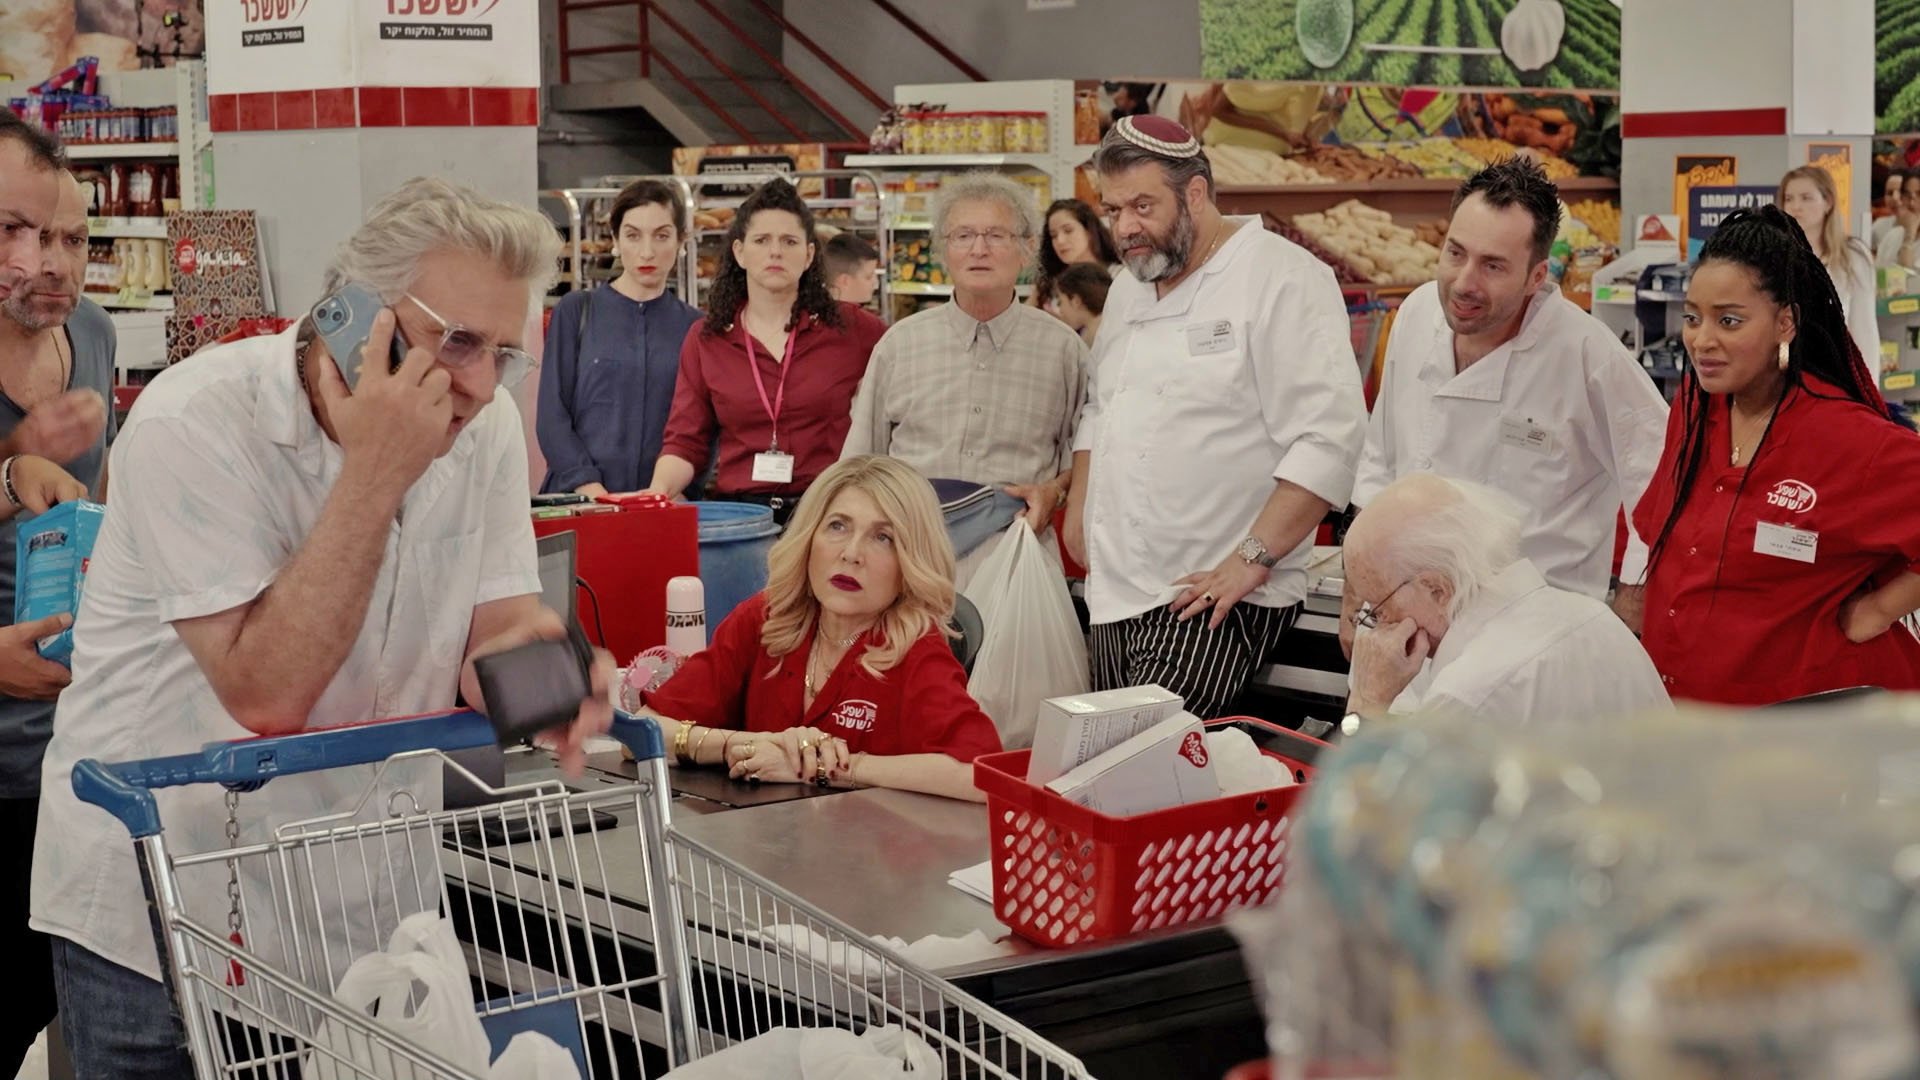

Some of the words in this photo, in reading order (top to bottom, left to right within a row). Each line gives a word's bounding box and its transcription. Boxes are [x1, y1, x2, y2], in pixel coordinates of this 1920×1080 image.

[384, 26, 402, 37] יקר
[404, 26, 436, 38] הלקוח
[457, 27, 488, 37] המחיר
[1739, 192, 1754, 208] לא
[1776, 484, 1798, 498] שפע
[1767, 491, 1804, 510] יששכר
[841, 704, 865, 718] שפע
[831, 712, 872, 730] יששכר
